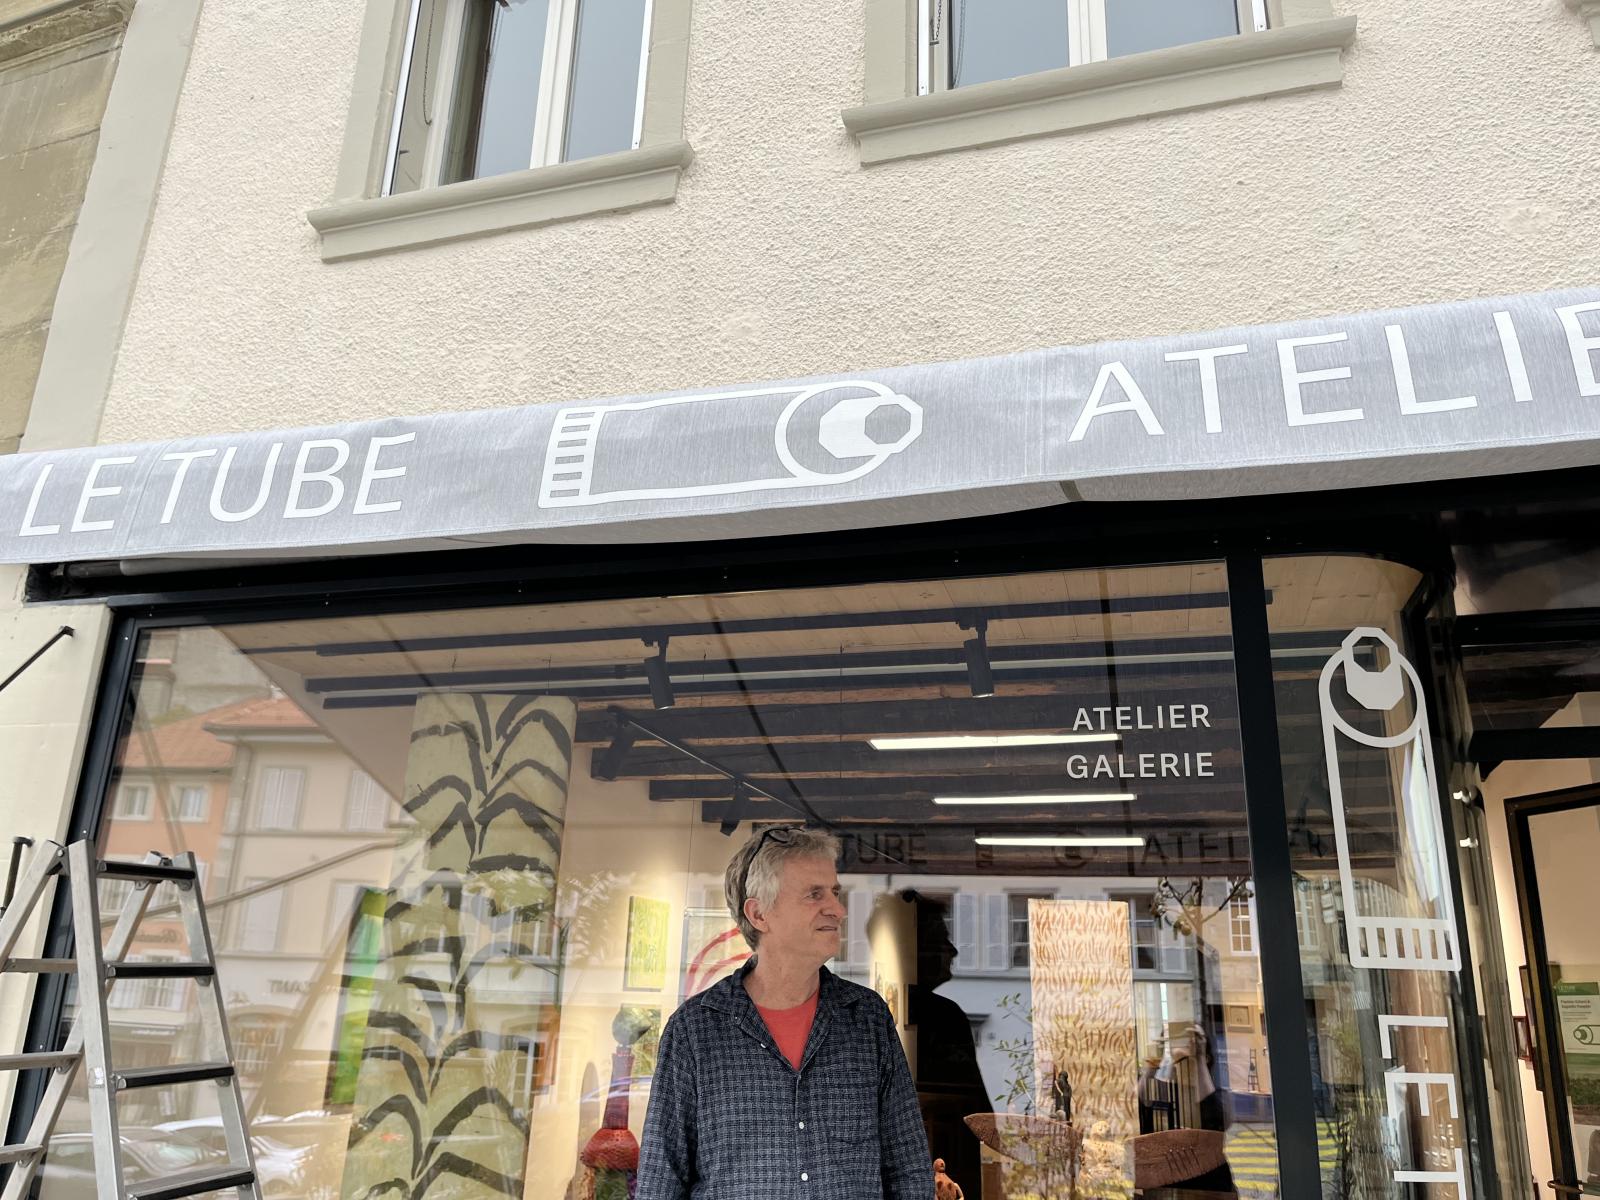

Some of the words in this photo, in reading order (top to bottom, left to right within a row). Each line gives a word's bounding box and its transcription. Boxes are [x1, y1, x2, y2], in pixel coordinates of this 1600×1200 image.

[19, 455, 138, 538] LE
[159, 431, 417, 525] TUBE
[1072, 703, 1212, 732] ATELIER
[1066, 752, 1215, 779] GALERIE
